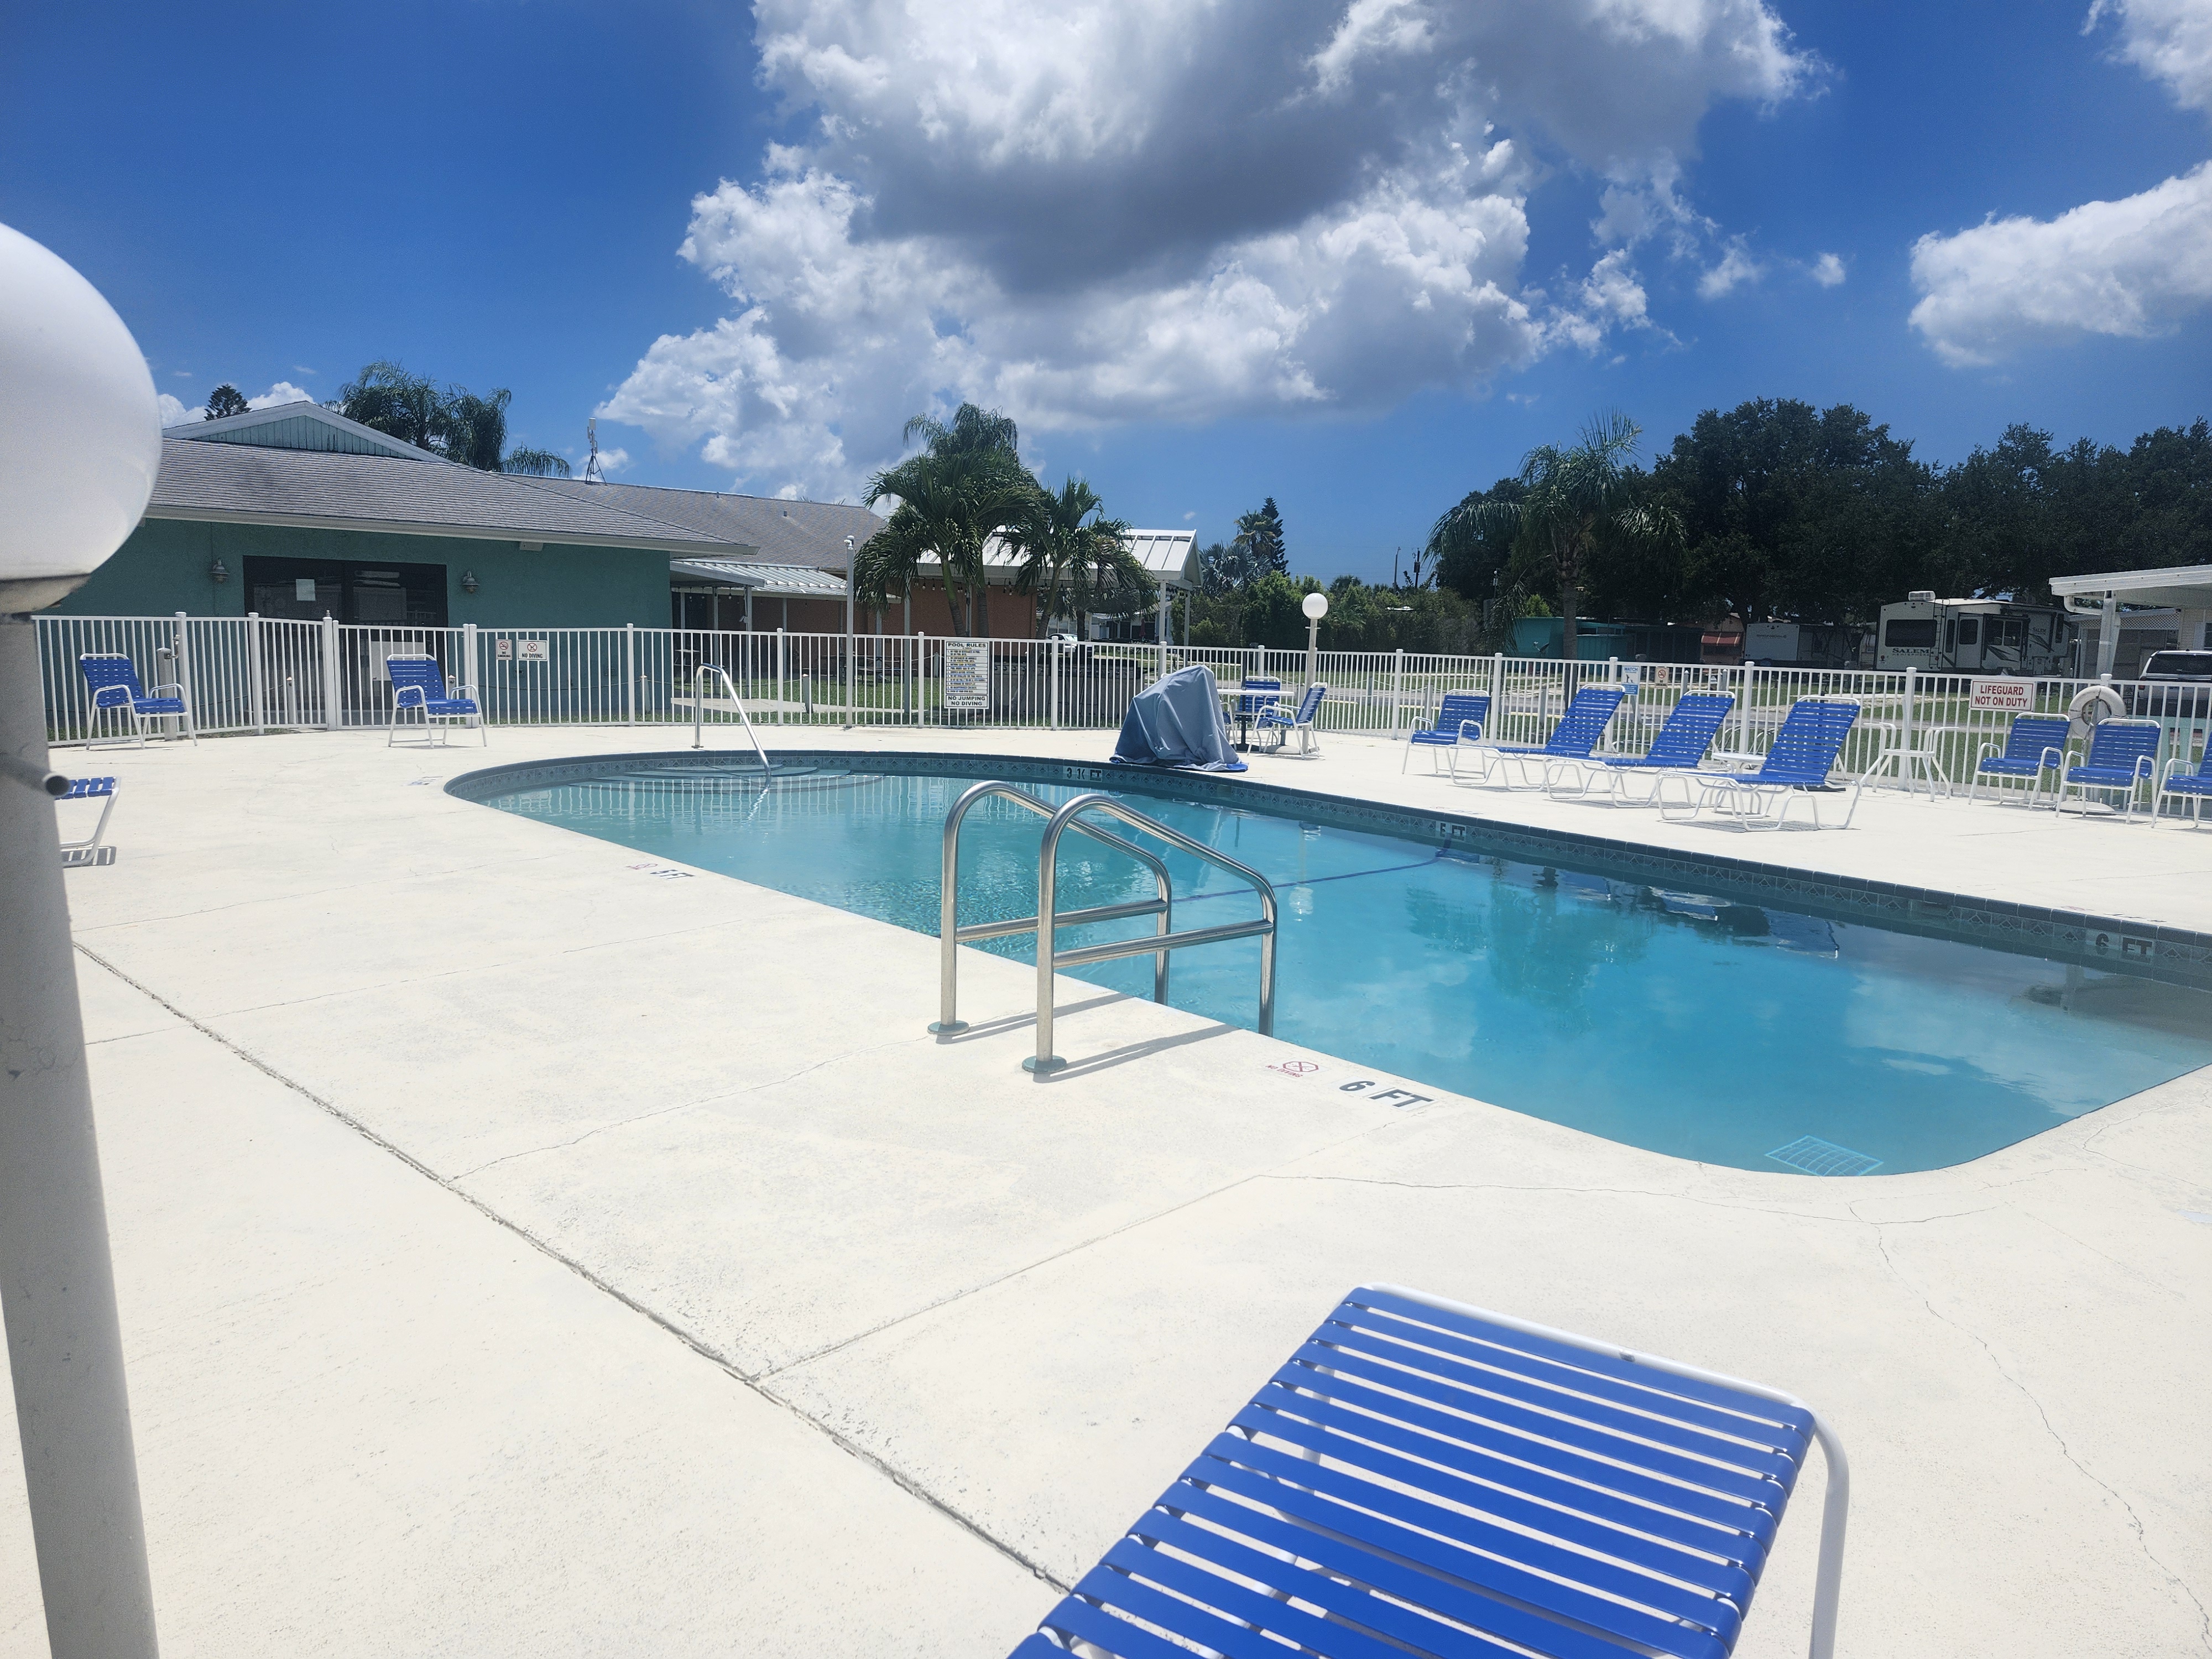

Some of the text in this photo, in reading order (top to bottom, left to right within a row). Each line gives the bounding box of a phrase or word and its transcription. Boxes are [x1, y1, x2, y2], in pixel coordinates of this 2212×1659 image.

[1980, 685, 2023, 695] LIFEGUARD
[1975, 696, 2028, 707] NOT ON DUTY
[2122, 936, 2152, 957] FT
[1339, 1081, 1435, 1107] 6 FT
